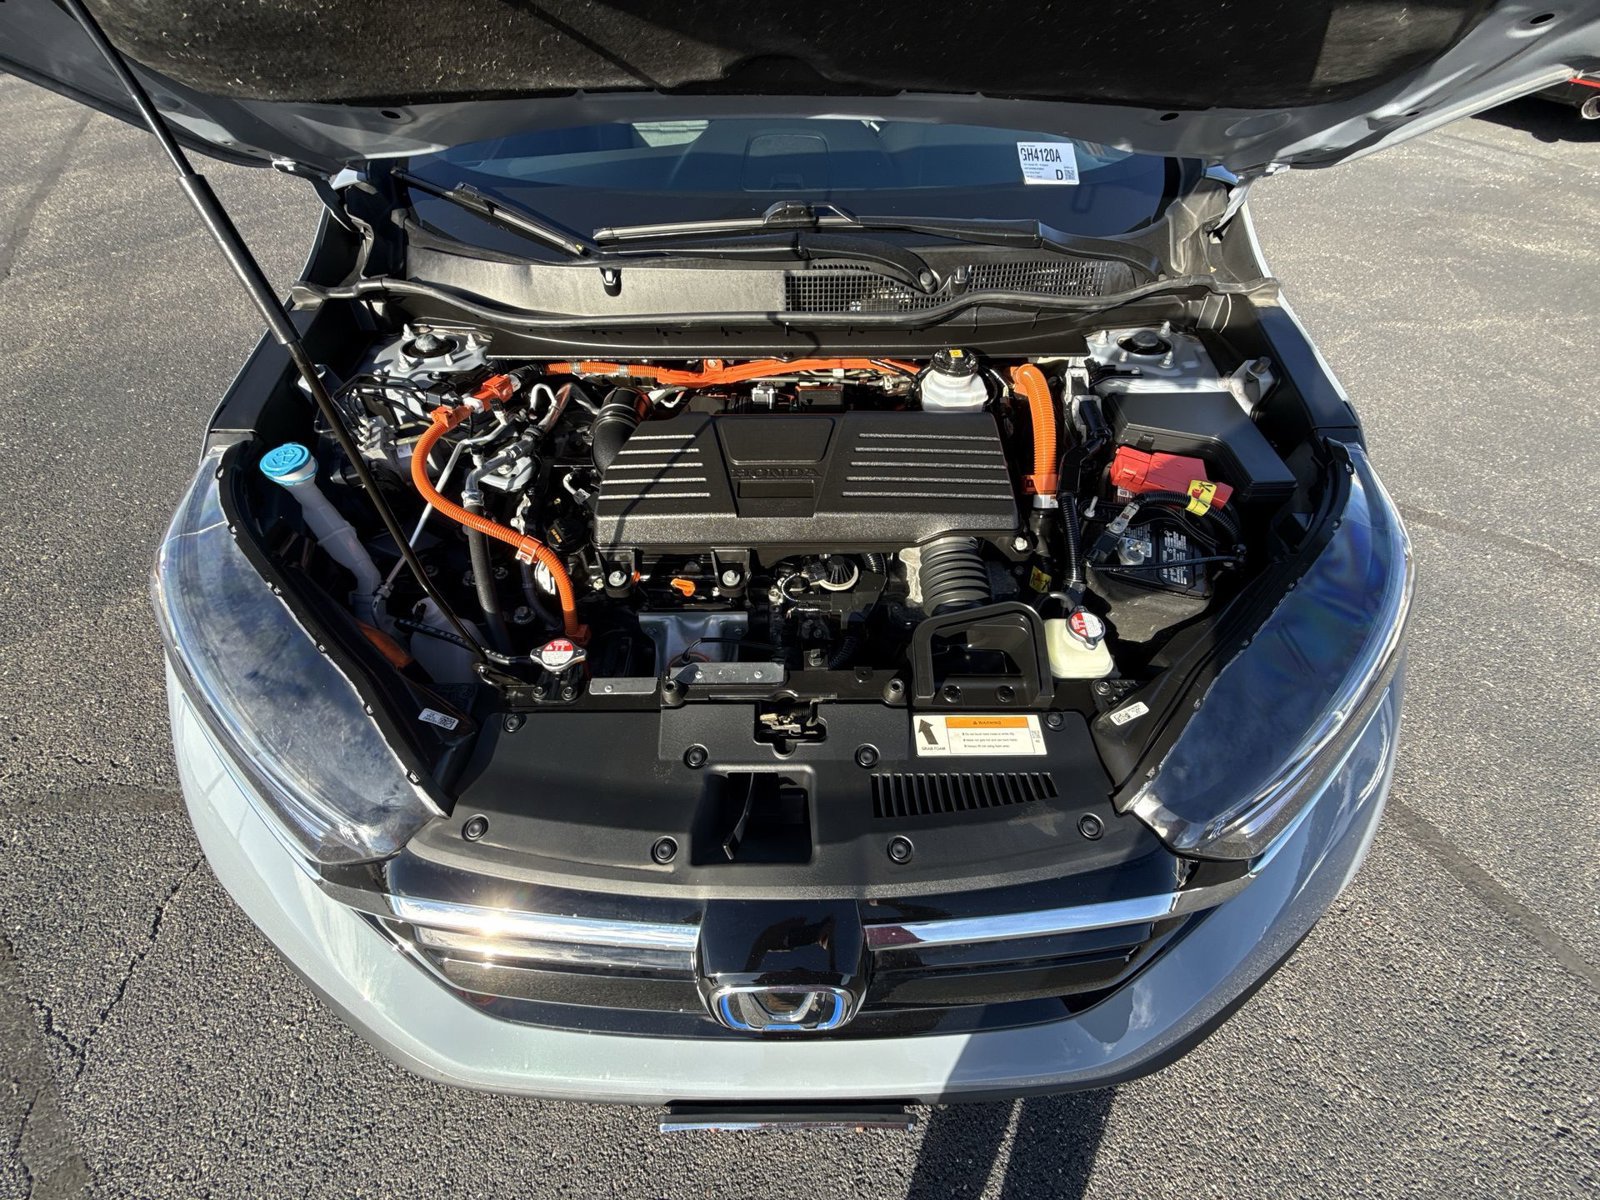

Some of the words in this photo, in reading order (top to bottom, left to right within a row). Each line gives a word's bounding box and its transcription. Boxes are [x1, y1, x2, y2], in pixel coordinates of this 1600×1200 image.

[1020, 148, 1062, 162] GH4120A
[1055, 169, 1064, 180] D
[730, 467, 823, 478] HONDA
